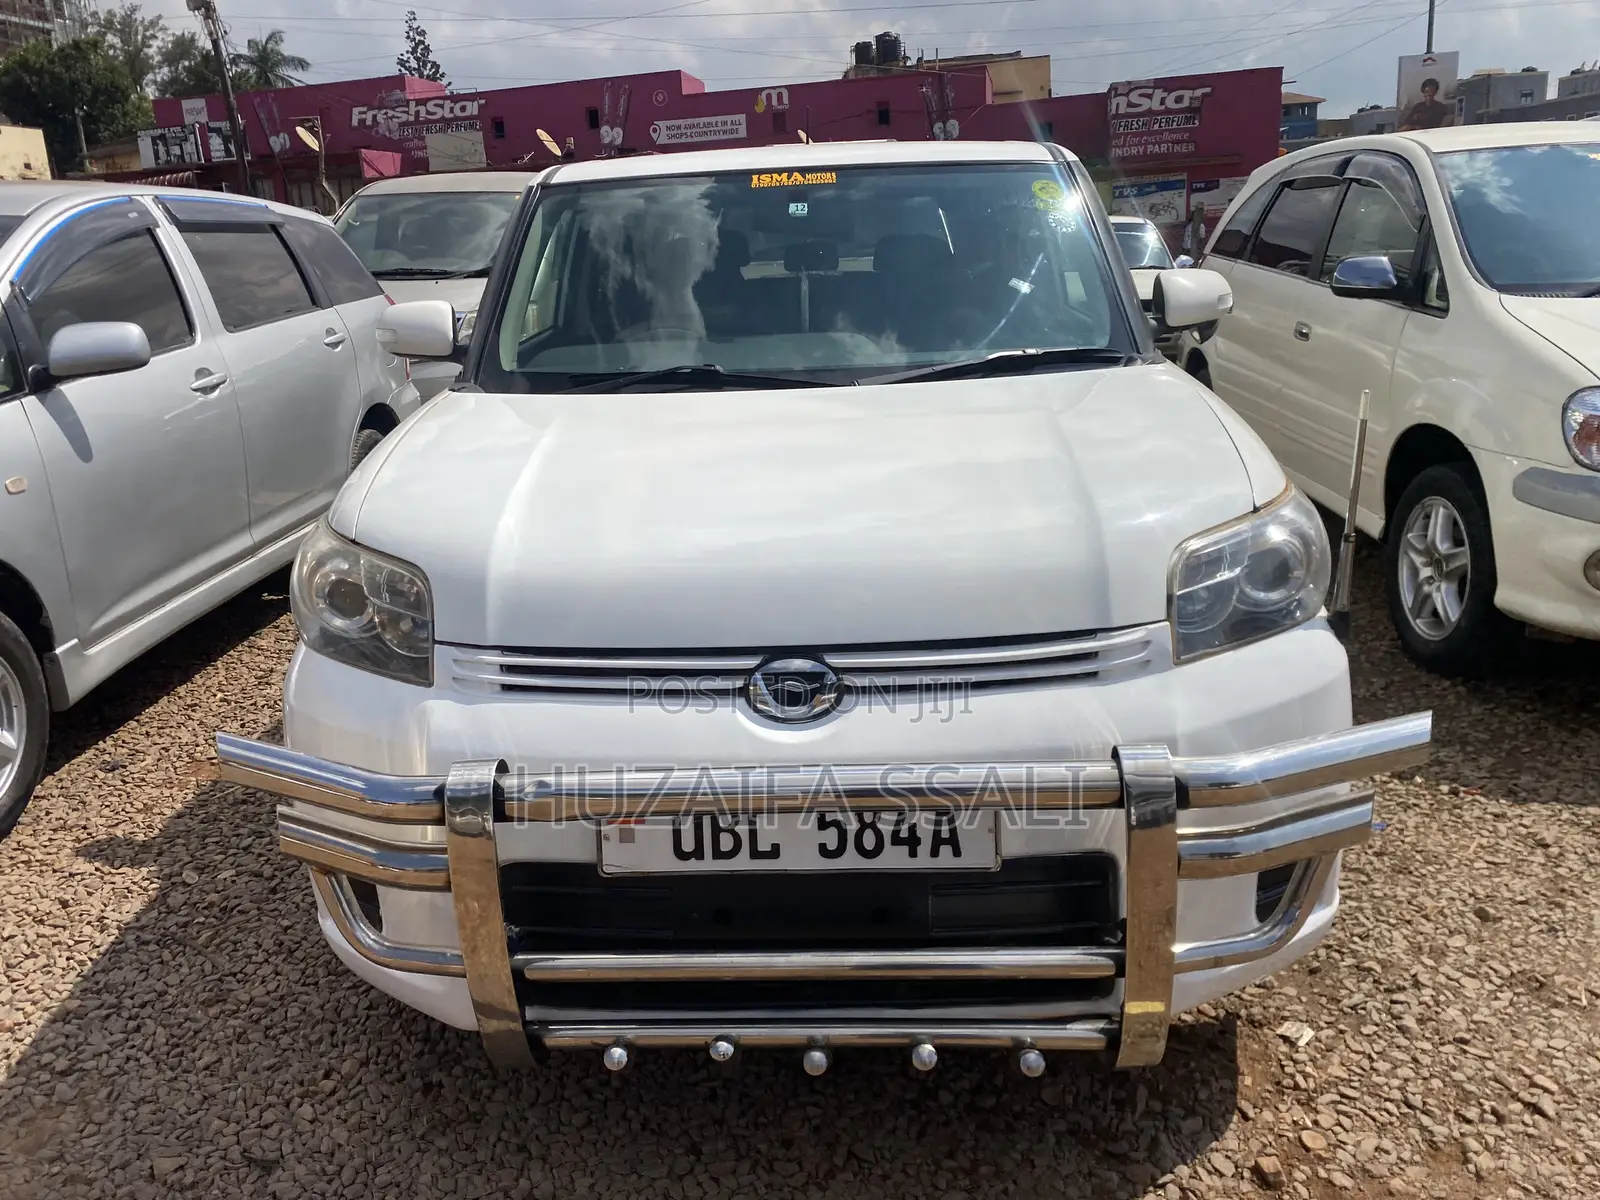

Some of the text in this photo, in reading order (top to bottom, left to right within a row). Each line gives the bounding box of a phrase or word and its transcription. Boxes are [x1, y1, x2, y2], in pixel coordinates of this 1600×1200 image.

[351, 98, 486, 127] FreshStar
[421, 124, 445, 135] FRESH
[445, 121, 480, 133] PERFUME
[665, 124, 682, 132] NOW
[683, 121, 719, 131] AVAILABLE
[730, 119, 743, 127] ALL
[1118, 118, 1148, 131] FRESH
[666, 128, 740, 140] SHOPS COUNTRYWIDE
[1125, 134, 1140, 146] for
[1141, 132, 1190, 144] excellence
[1147, 142, 1196, 154] PARTNER
[751, 172, 837, 184] ISMA MOTORS
[1114, 186, 1138, 197] TVS
[795, 204, 806, 212] 12
[817, 811, 963, 859] 584A
